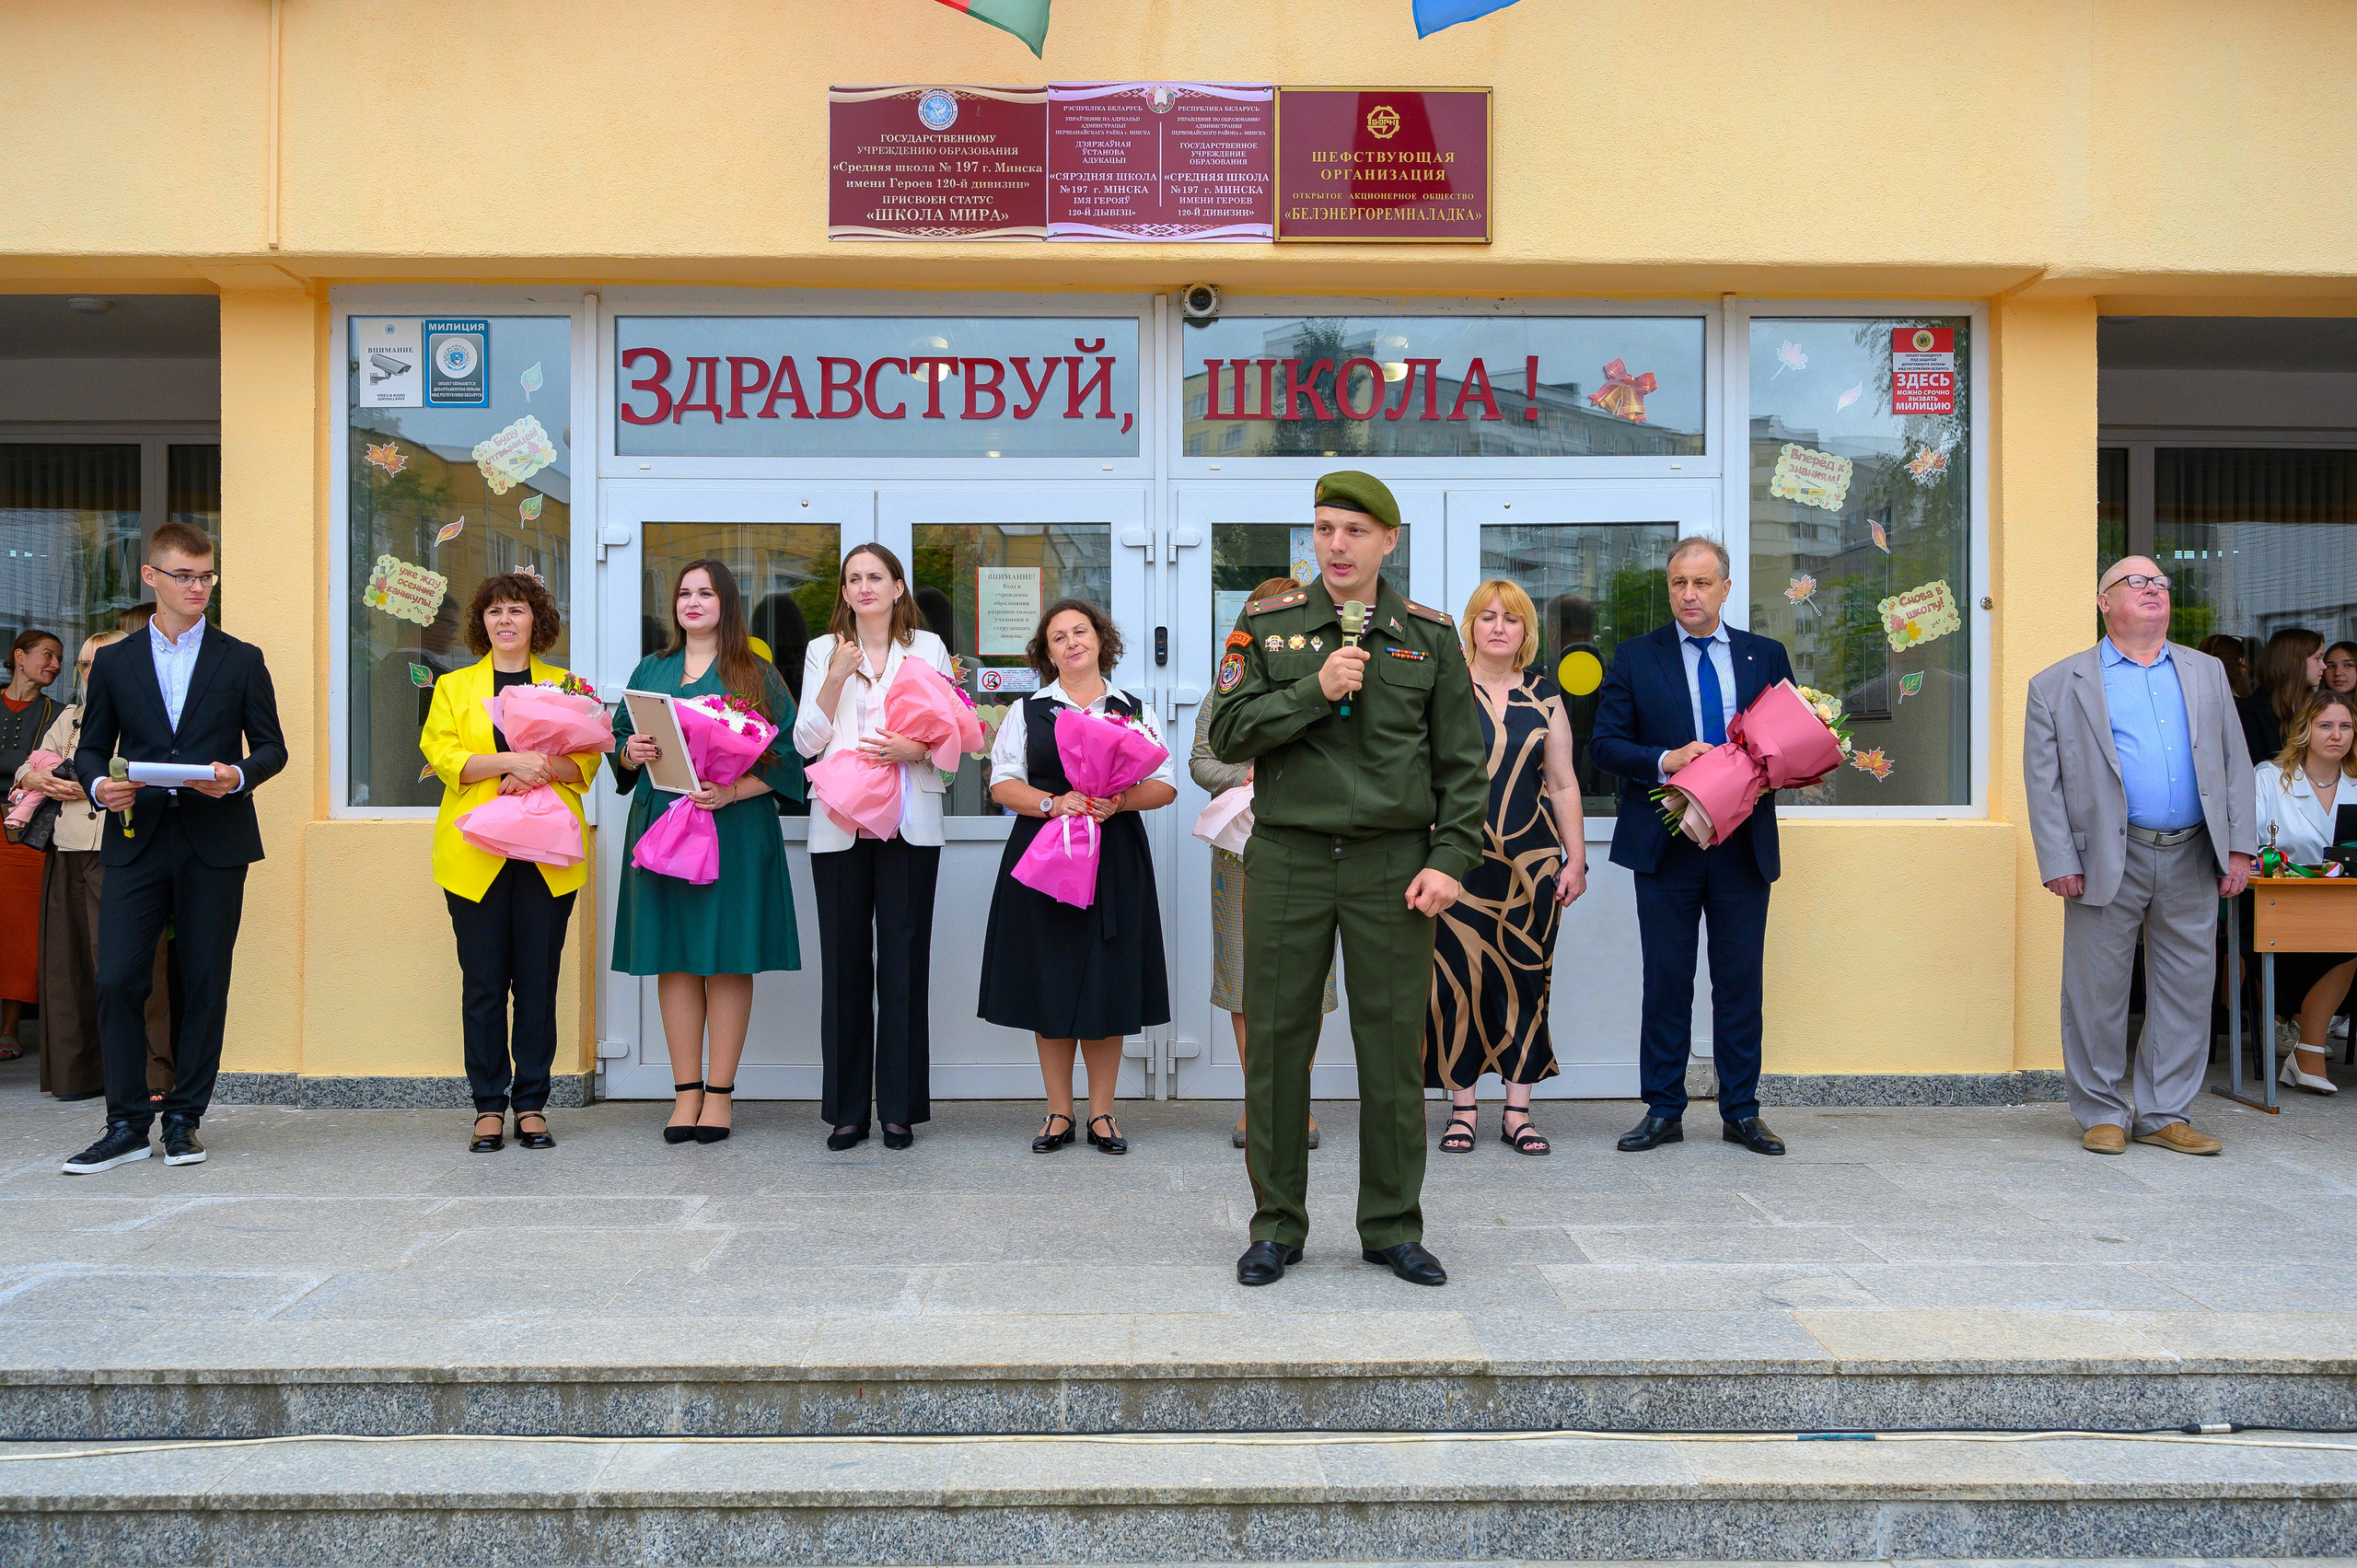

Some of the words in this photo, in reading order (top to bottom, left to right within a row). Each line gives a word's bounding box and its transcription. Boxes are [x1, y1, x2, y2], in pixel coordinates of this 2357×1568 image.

[880, 134, 996, 144] ГОСУДАРСТВЕННОМУ
[1075, 140, 1131, 148] ДЗЯРЖАЎНАЯ
[857, 146, 936, 156] УЧРЕЖДЕНИЮ
[939, 146, 1018, 155] ОБРАЗОВАНИЯ
[1312, 151, 1455, 164] ШЕФСТВУЮЩАЯ
[833, 162, 891, 173] «Средняя
[939, 162, 951, 172] №
[957, 162, 978, 172] 197
[995, 163, 1042, 173] Минска
[1050, 172, 1112, 181] «СЯРЭДНЯЯ
[1164, 173, 1223, 182] «СРЕДНЯЯ
[1226, 173, 1270, 181] ШКОЛА
[1321, 168, 1446, 182] ОРГАНИЗАЦИЯ
[846, 180, 886, 188] имени
[889, 178, 933, 189] Героев
[936, 179, 968, 189] 120-й
[971, 180, 1029, 190] дивизии»
[1104, 185, 1149, 193] МІНСКА
[882, 195, 946, 204] ПРИСВОЕН
[950, 195, 993, 204] СТАТУС
[1094, 195, 1130, 203] ГЕРОЯЎ
[1349, 192, 1417, 201] АКЦИОНЕРНОЕ
[866, 209, 945, 221] «ШКОЛА
[950, 209, 1009, 221] МИРА»
[1069, 207, 1091, 215] 120-Й
[1178, 207, 1201, 215] 120-Й
[1284, 207, 1481, 223] «БЕЛЭНЕРГОРЕМНАЛАДКА»
[1897, 374, 1950, 389] ЗДЕСЬ
[1896, 402, 1951, 412] МИЛИЦИЮ
[493, 428, 517, 447] Буду
[1791, 448, 1835, 471] Вперёд
[1789, 464, 1840, 484] знаниям!
[399, 567, 418, 579] уже
[421, 575, 441, 588] жду
[398, 578, 435, 597] осенние
[1899, 589, 1933, 607] Снова
[1906, 597, 1945, 620] школу!
